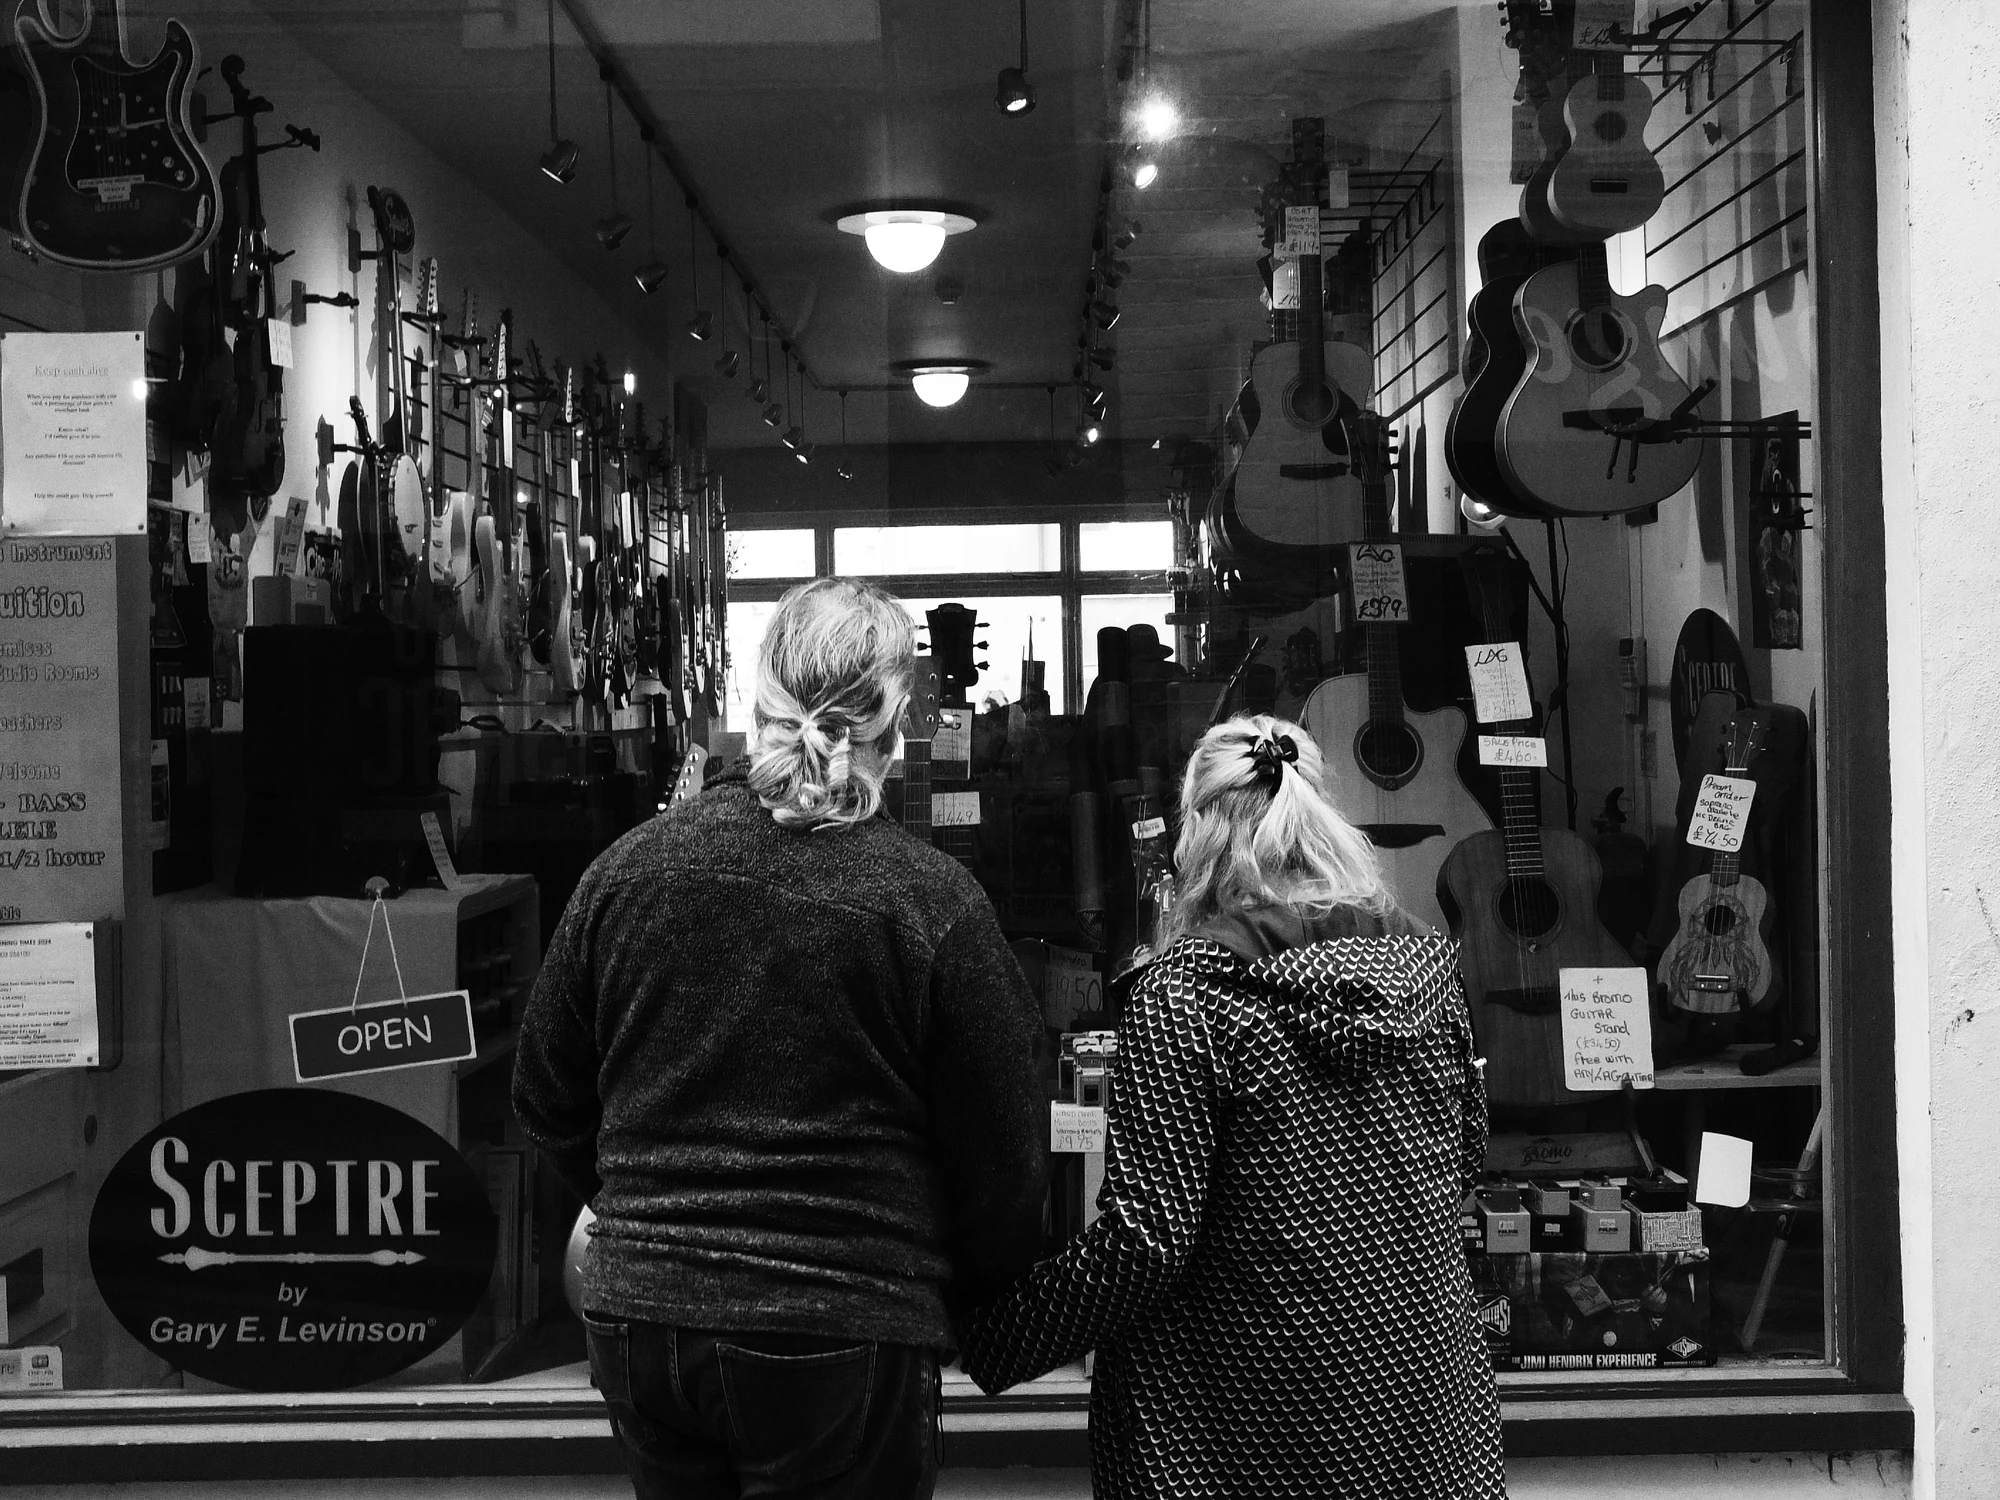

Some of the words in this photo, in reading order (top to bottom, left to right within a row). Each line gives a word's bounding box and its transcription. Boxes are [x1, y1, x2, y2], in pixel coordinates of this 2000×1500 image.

[35, 366, 60, 378] Keep
[63, 366, 85, 377] cash
[86, 366, 109, 377] alive
[11, 542, 112, 562] Instrument
[1474, 648, 1508, 667] LAG
[45, 662, 99, 682] Rooms
[1704, 776, 1732, 791] Dream
[18, 792, 87, 813] BASS
[46, 848, 106, 867] hour
[1564, 988, 1586, 1003] This
[1570, 1007, 1616, 1020] GUITAR
[337, 1013, 433, 1056] OPEN
[1594, 1020, 1631, 1036] Stand
[150, 1136, 440, 1239] SCEPTRE
[277, 1281, 308, 1305] by
[150, 1316, 228, 1349] Gary
[236, 1317, 266, 1343] E.
[1521, 1354, 1546, 1370] JIMI
[1548, 1353, 1594, 1369] HENDRIX
[1596, 1352, 1658, 1368] EXPERIENCE
